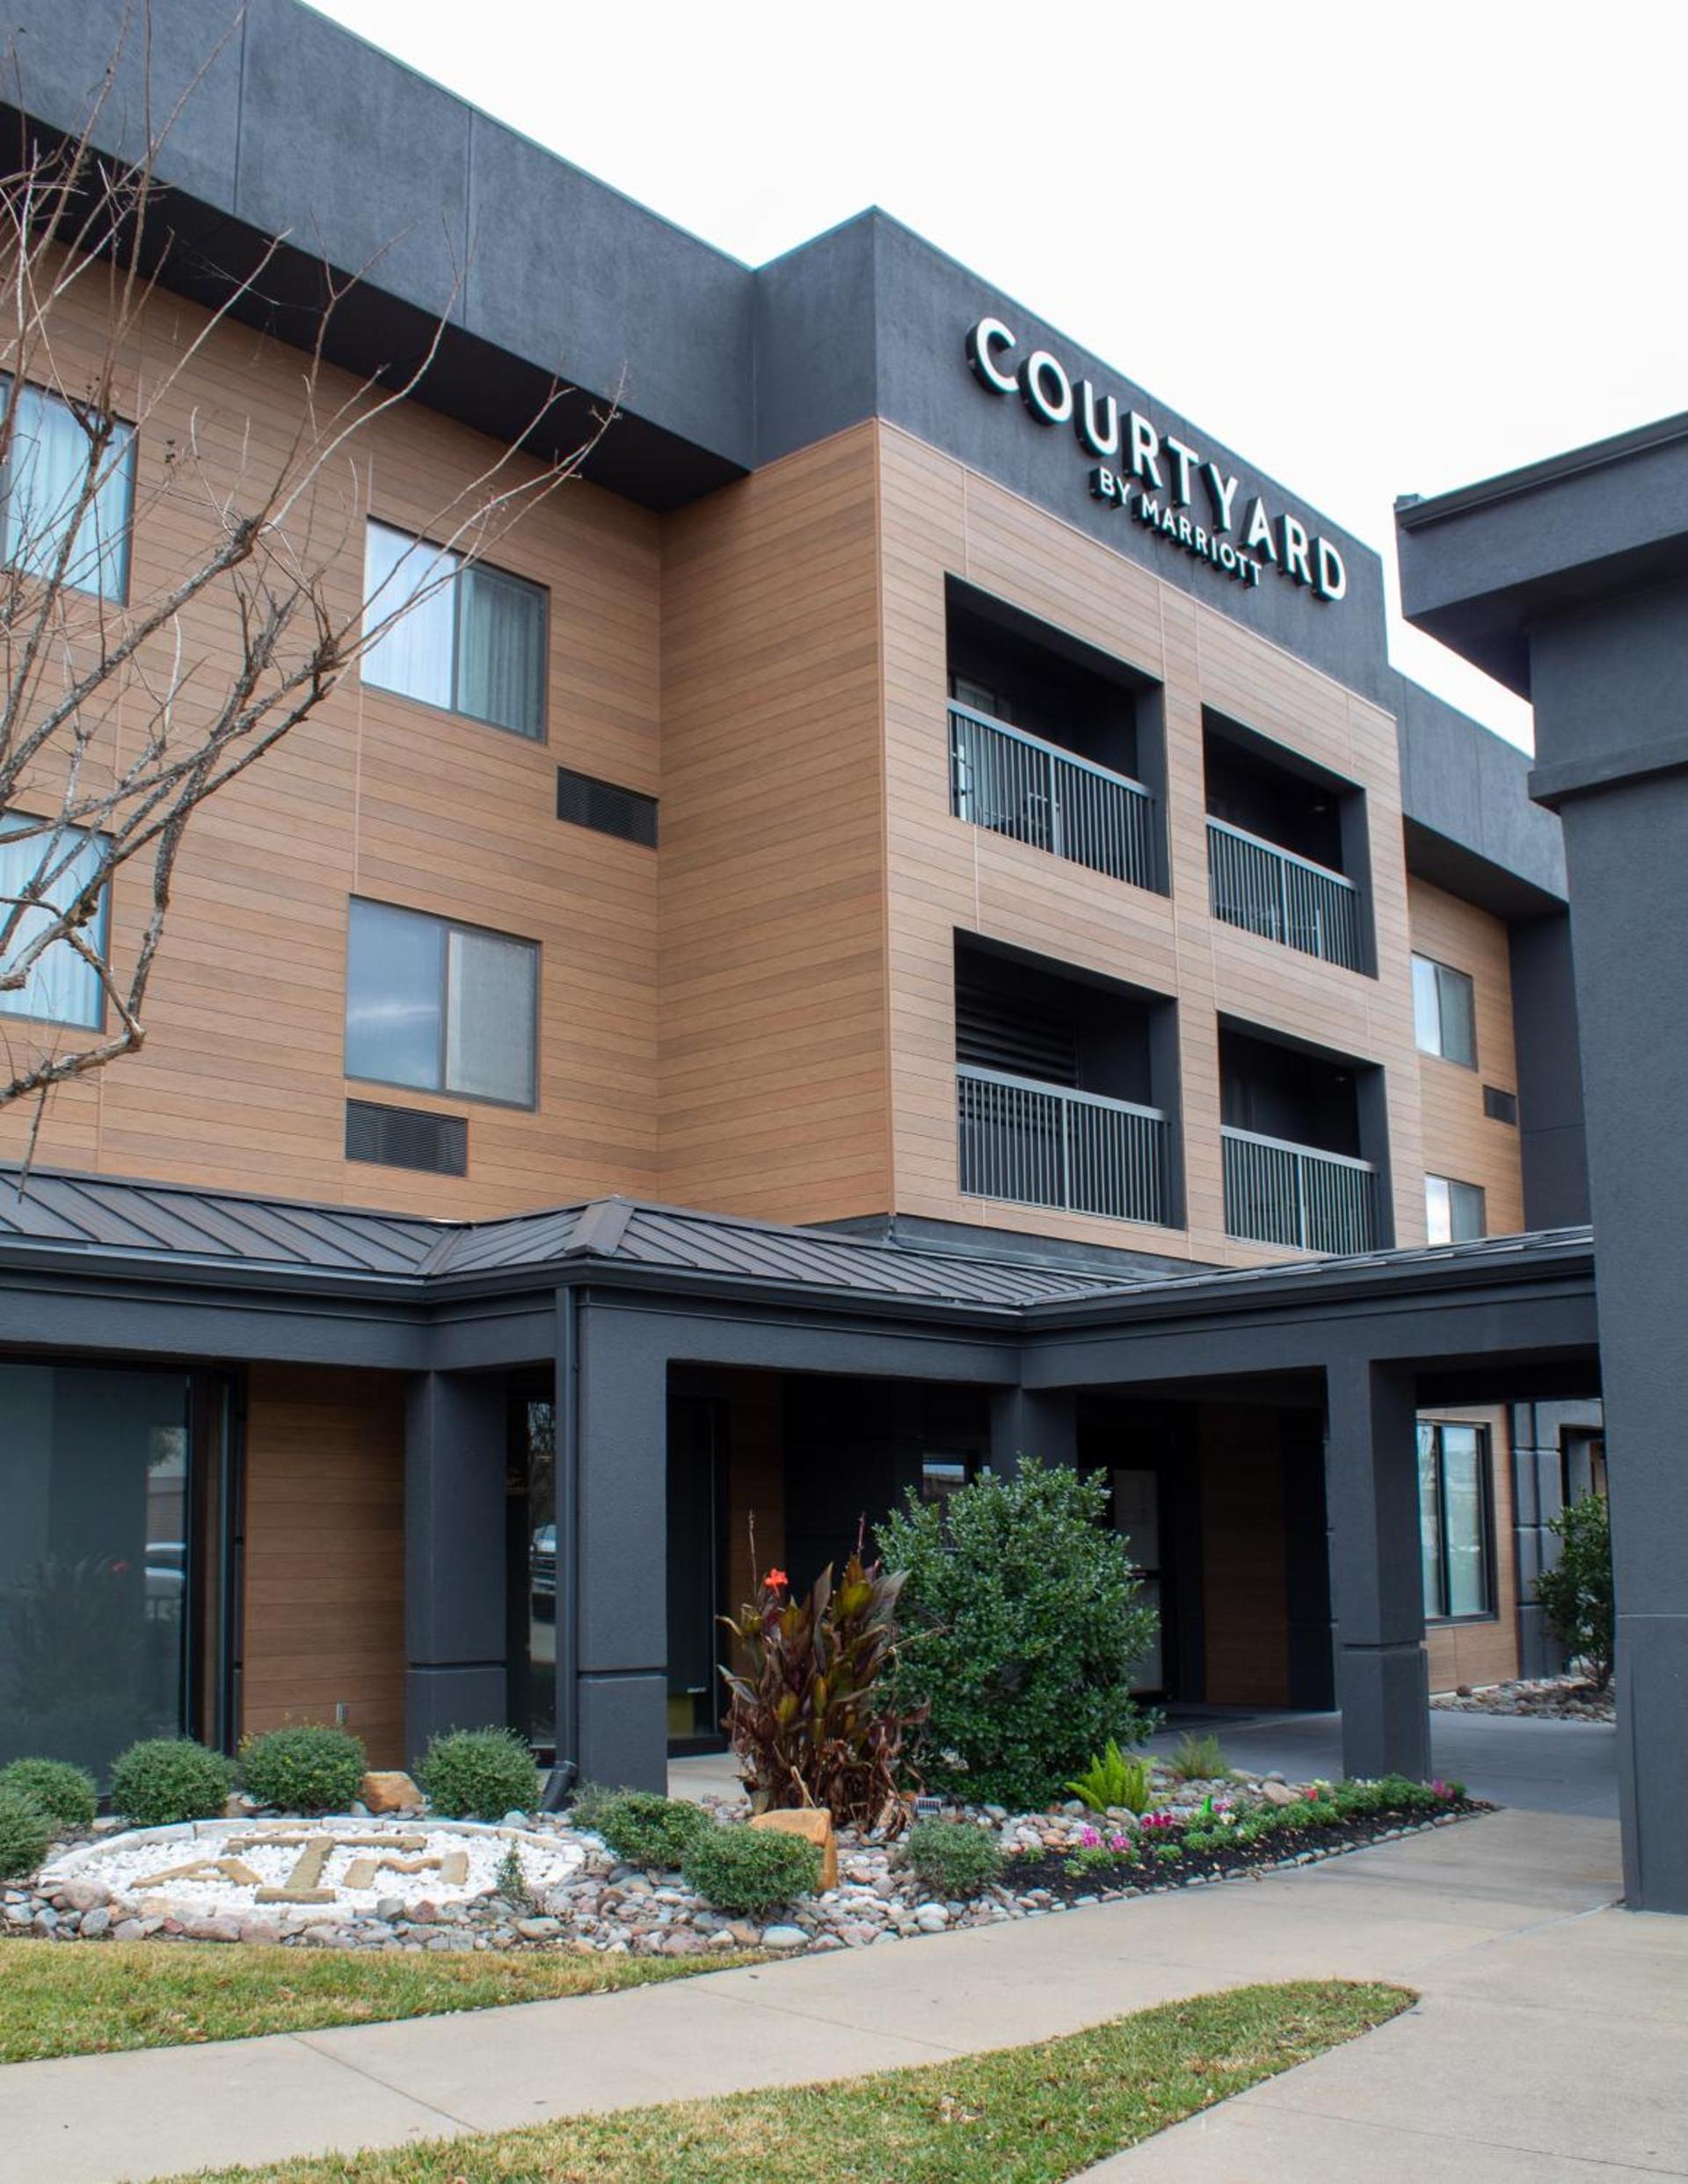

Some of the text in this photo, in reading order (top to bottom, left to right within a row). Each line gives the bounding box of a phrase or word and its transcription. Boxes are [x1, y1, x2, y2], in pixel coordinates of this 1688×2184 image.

[972, 317, 1347, 601] COURTYARD
[1095, 467, 1262, 586] BY MARRIOTT
